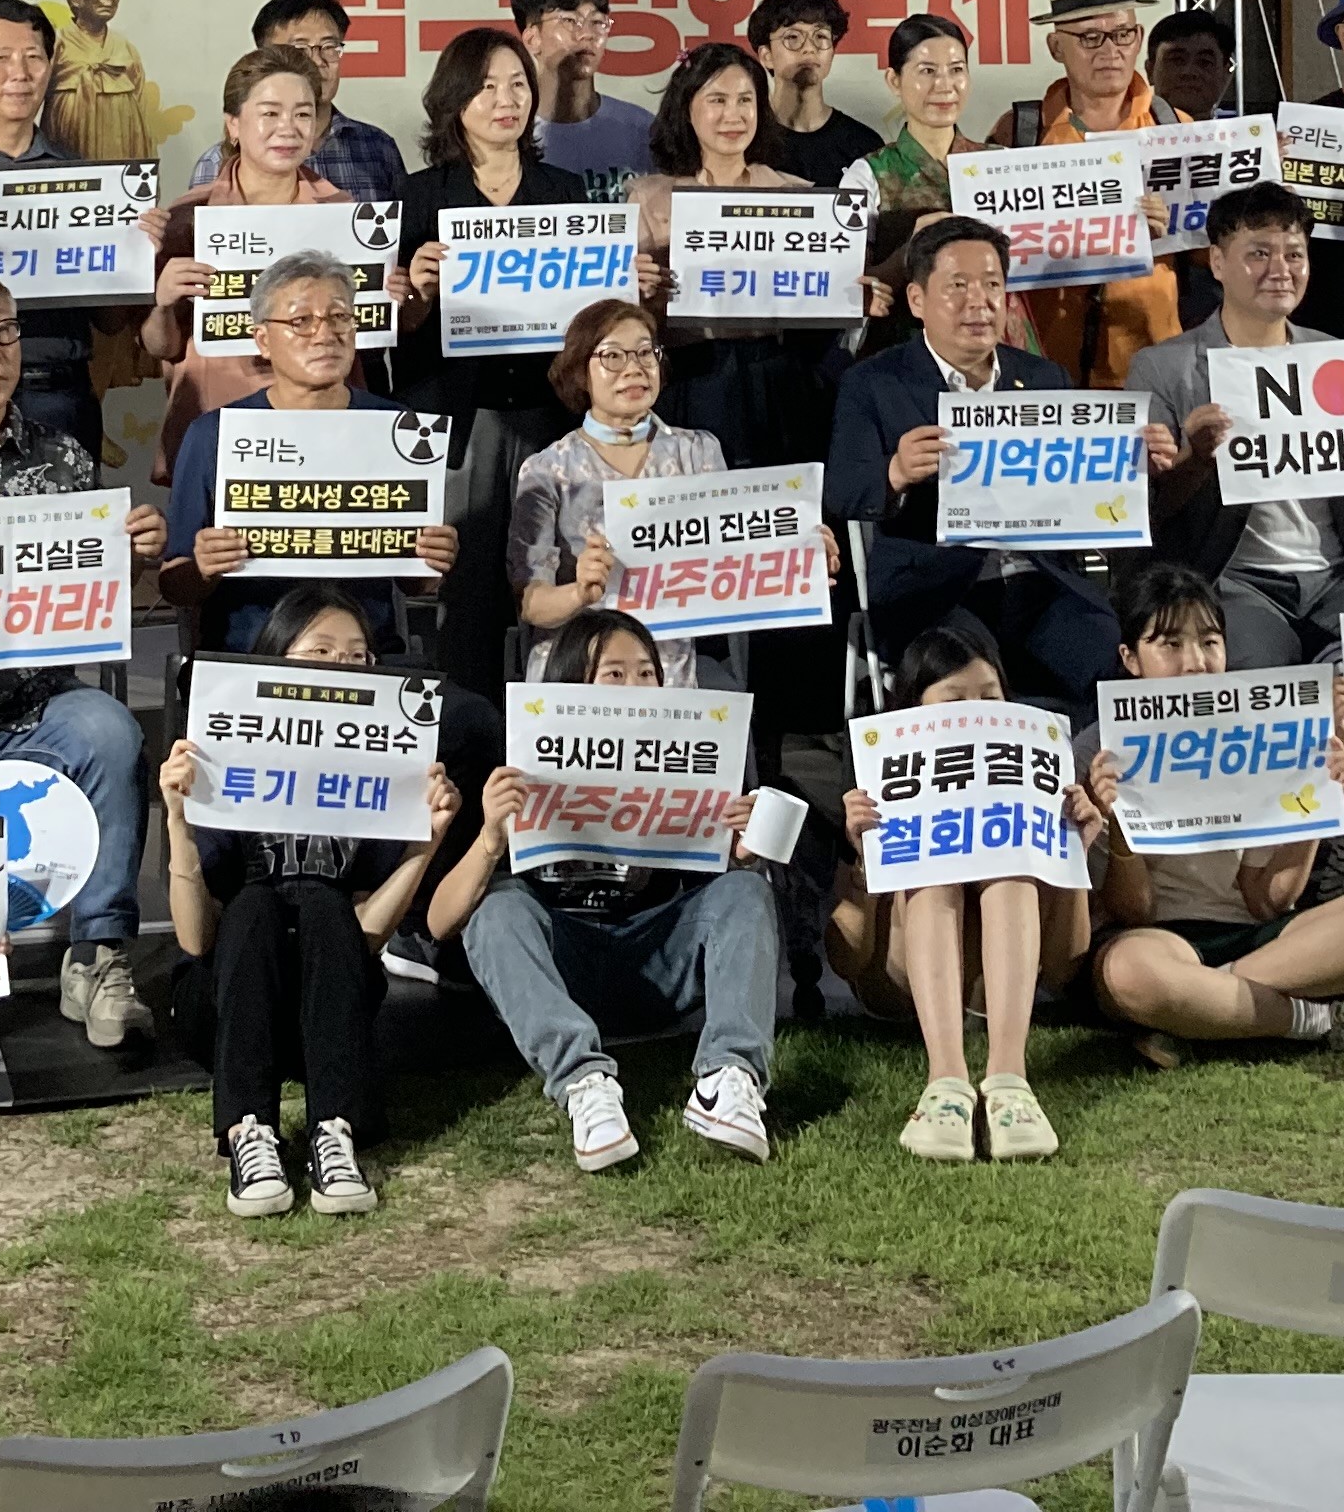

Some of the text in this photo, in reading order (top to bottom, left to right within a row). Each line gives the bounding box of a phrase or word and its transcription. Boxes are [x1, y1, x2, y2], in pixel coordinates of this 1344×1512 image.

[1288, 125, 1342, 152] 우리는,
[1283, 160, 1314, 184] 일본
[974, 178, 1122, 215] 역사의 진실을
[69, 204, 138, 227] 오염수
[451, 214, 627, 240] 피해자들의 용기를
[208, 232, 274, 256] 우리는,
[684, 230, 850, 254] 후쿠시마 오염수
[996, 214, 1138, 265] 주하라!
[56, 245, 116, 275] 반대
[452, 245, 634, 294] 기억하라!
[700, 270, 829, 297] 투기 반대
[450, 316, 471, 324] 2023
[951, 403, 1136, 428] 피해자들의 용기를
[231, 437, 305, 466] 우리는,
[951, 435, 1144, 487] 기억하라!
[228, 483, 410, 510] 일본 방사성 오염수
[947, 508, 970, 516] 2023
[631, 507, 799, 552] 역사의 진실을
[15, 538, 104, 573] 진실을
[617, 548, 816, 612] 마주하라!
[1113, 680, 1320, 722] 피해자들의 용기를
[206, 712, 418, 754] 후쿠시마 오염수
[1118, 717, 1331, 784] 기억하라!
[535, 735, 719, 774] 역사의 진실을
[881, 742, 1060, 802] 방류결정
[222, 766, 390, 811] 투기 반대
[513, 782, 730, 838] 마주하라!
[879, 801, 1068, 866] 철회하라!
[897, 1416, 1035, 1458] 이순화 대표
